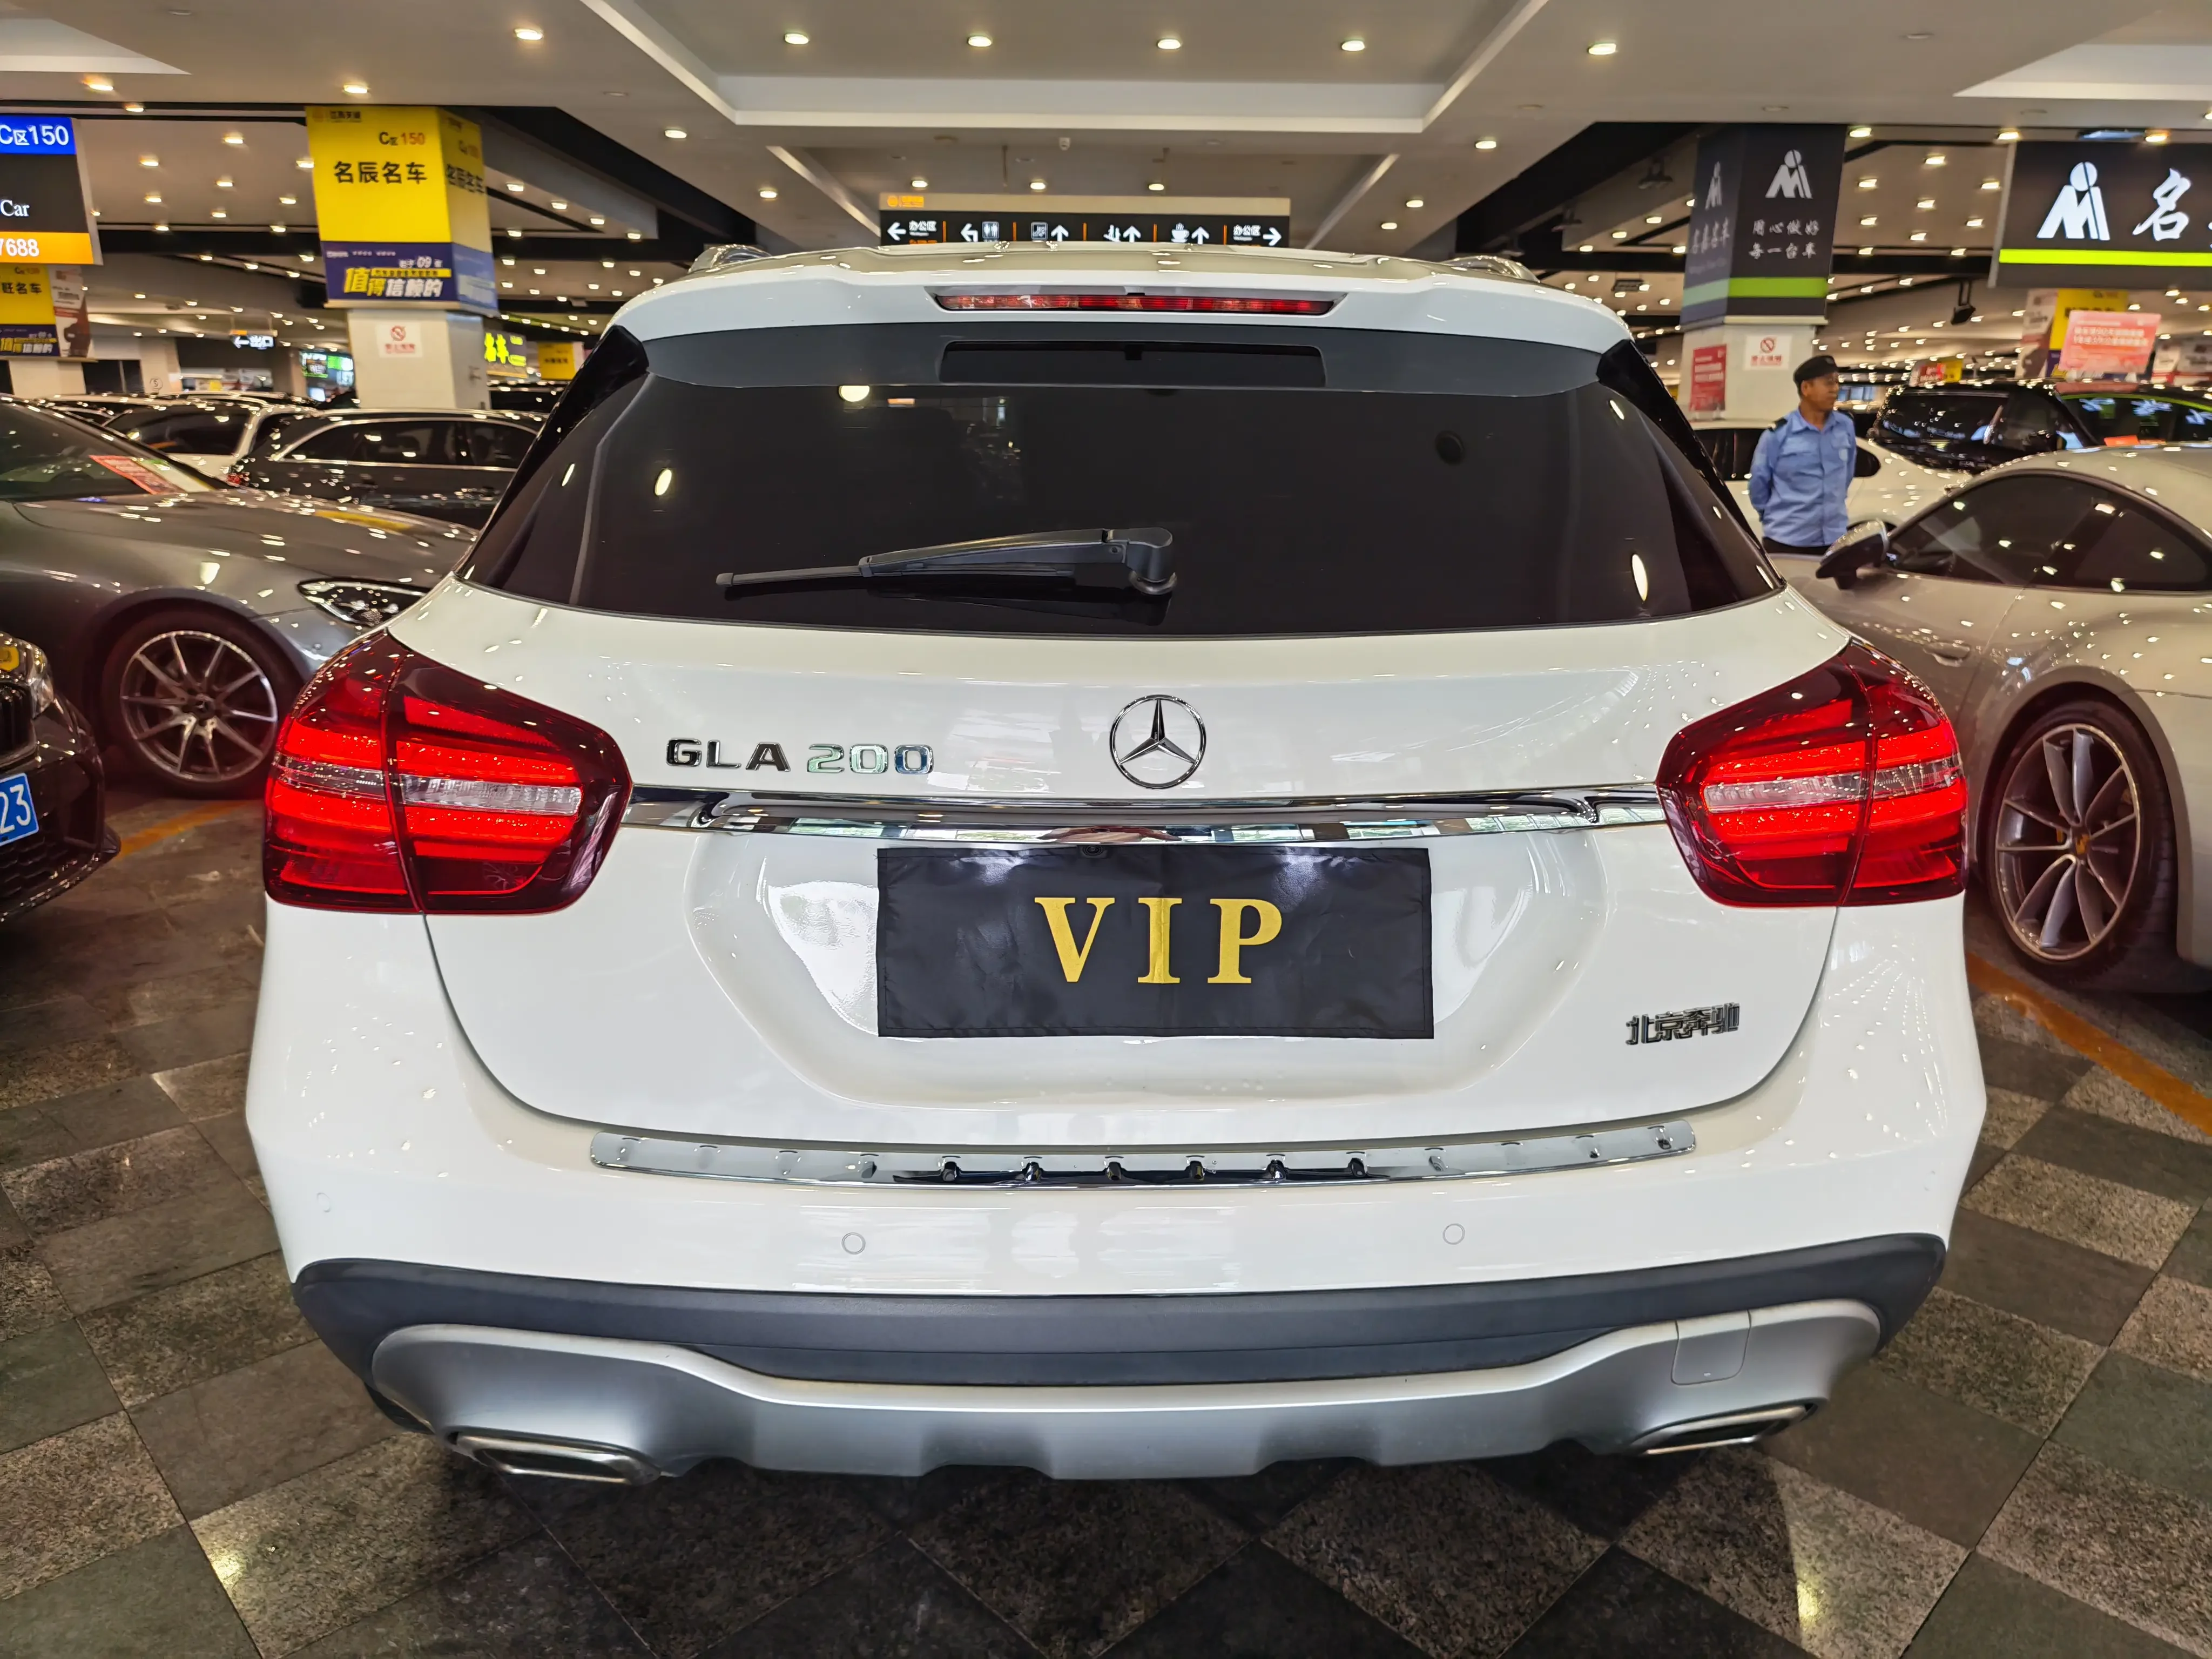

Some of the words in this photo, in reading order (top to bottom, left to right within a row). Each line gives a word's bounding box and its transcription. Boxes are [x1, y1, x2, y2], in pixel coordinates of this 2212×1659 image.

[334, 161, 428, 184] 名辰名车
[0, 199, 30, 217] Car
[2132, 168, 2212, 248] 名
[908, 220, 937, 232] 办公区
[1233, 225, 1261, 237] 办公区
[666, 737, 791, 772] GLA
[806, 743, 934, 775] 200
[1034, 896, 1283, 984] VIP
[1625, 1002, 1741, 1046] 北京奔驰
